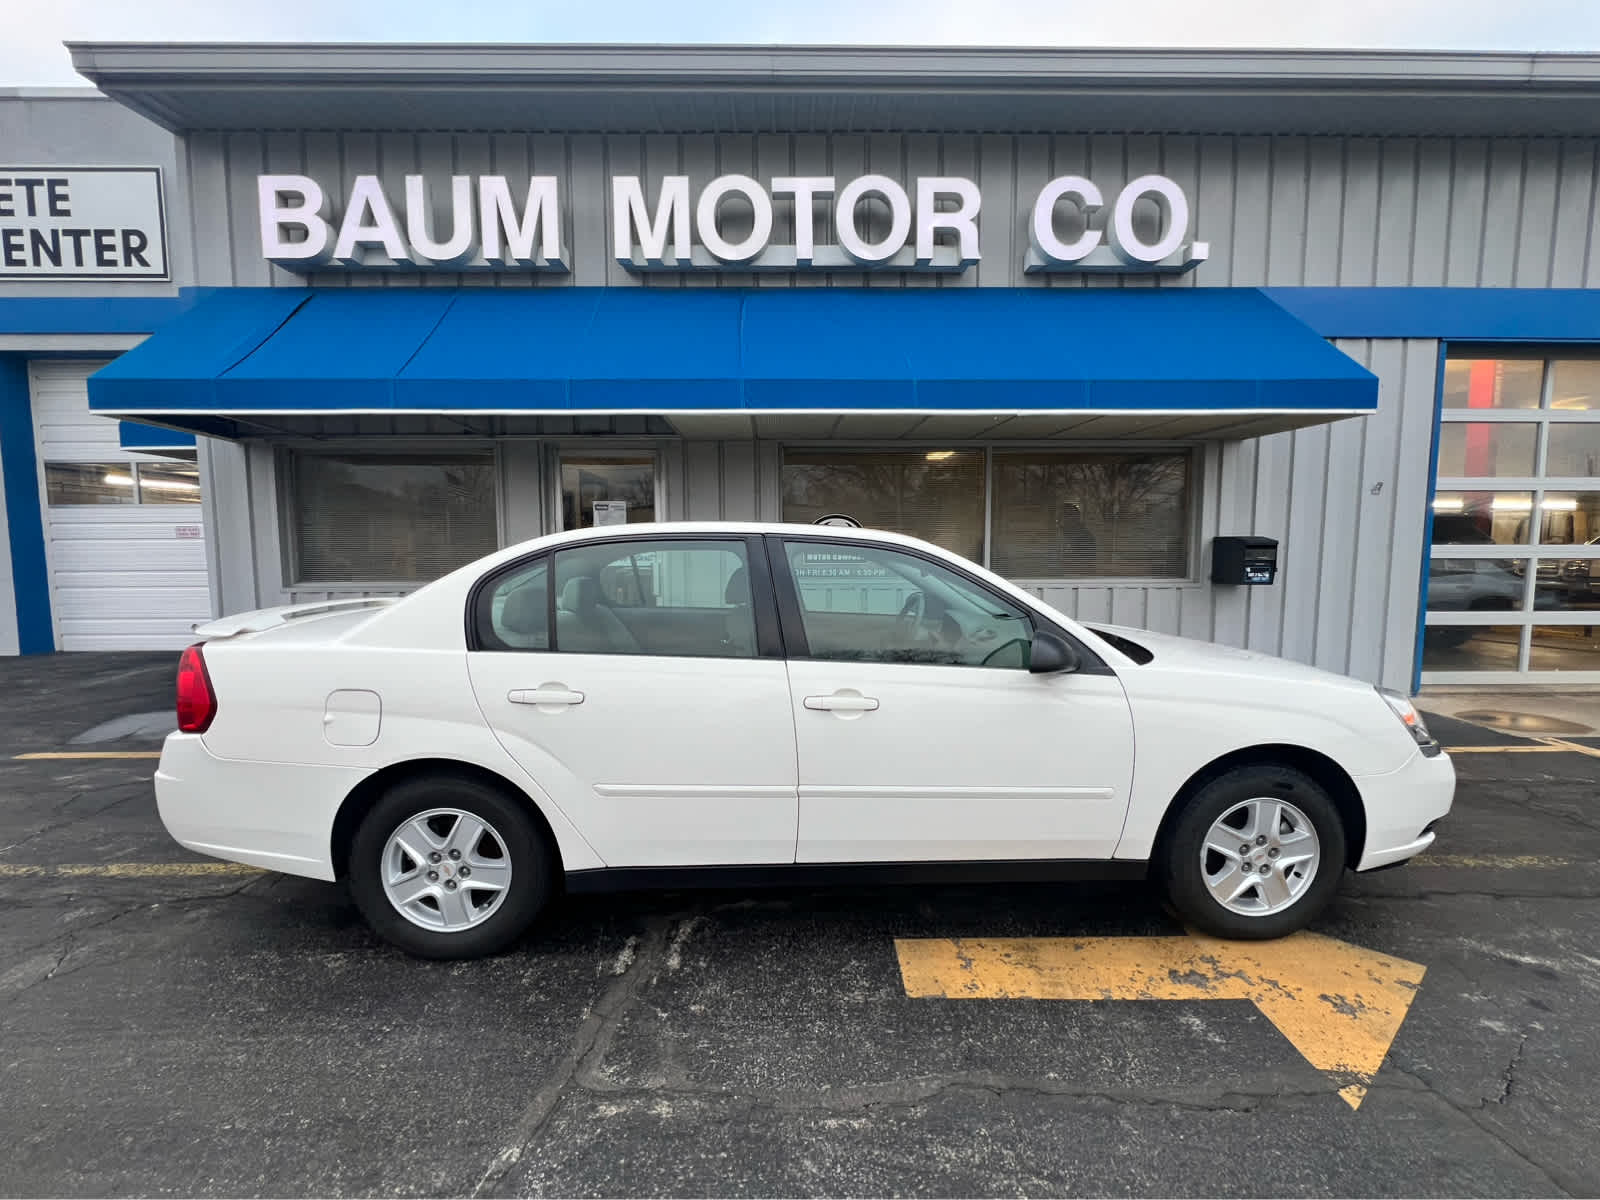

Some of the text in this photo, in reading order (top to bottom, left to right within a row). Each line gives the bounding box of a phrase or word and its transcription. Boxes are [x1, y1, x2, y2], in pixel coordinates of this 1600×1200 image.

[0, 178, 72, 217] ETE
[257, 174, 1210, 262] BAUM MOTOR CO.
[1, 228, 151, 267] ENTER
